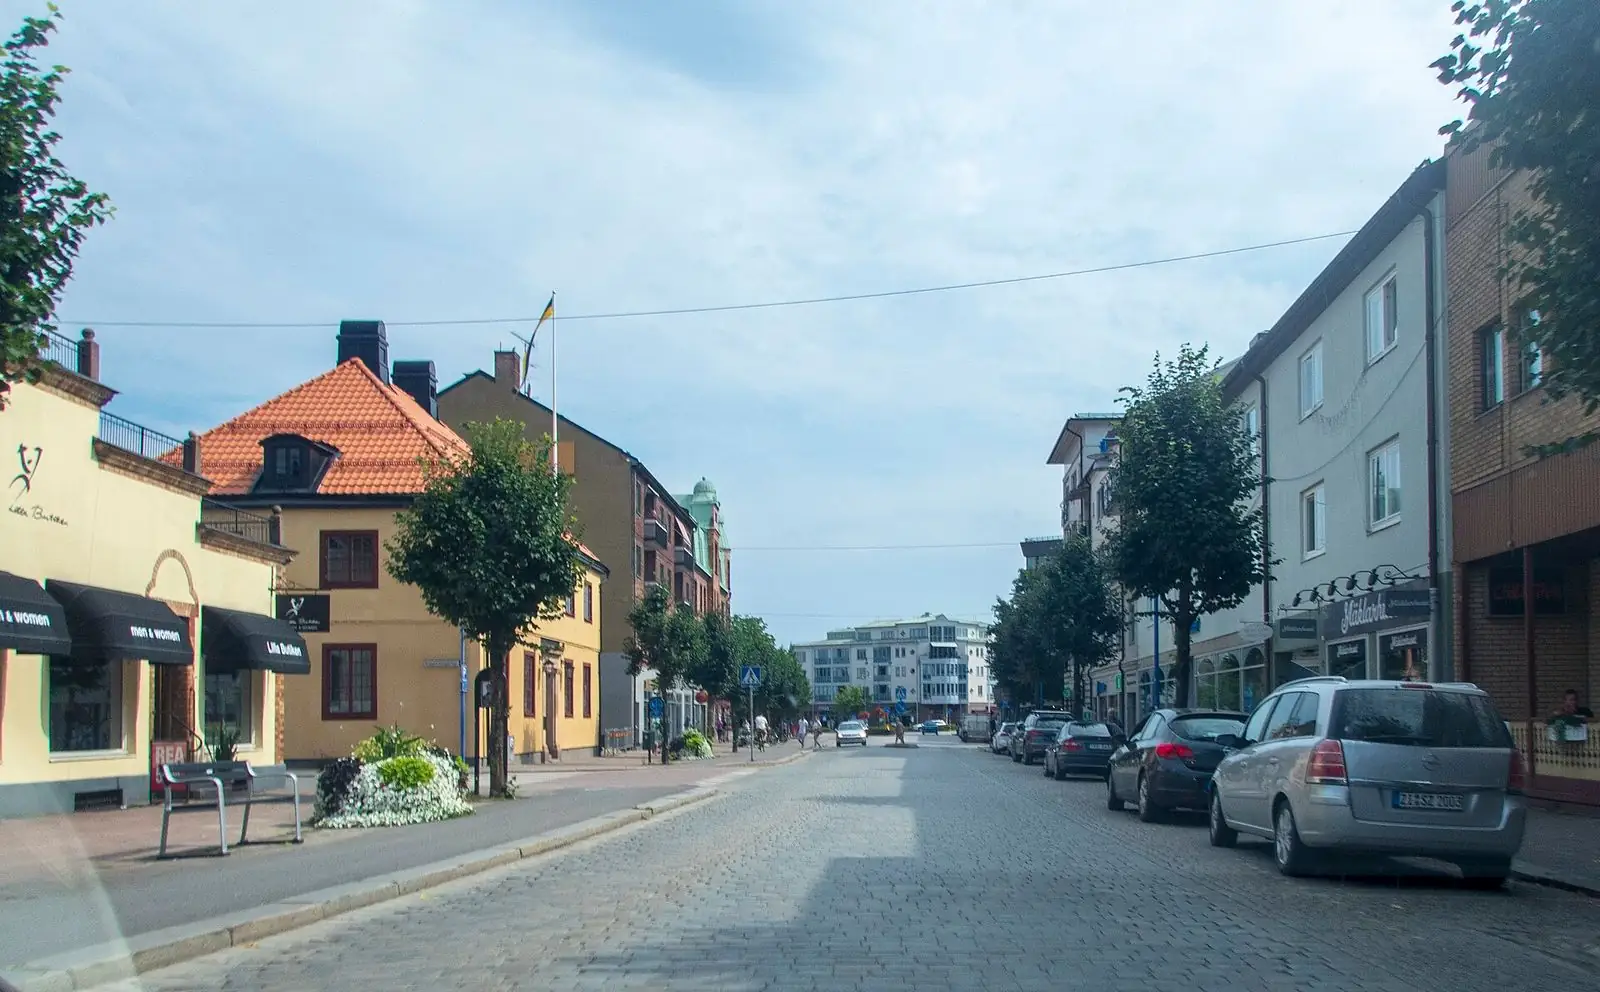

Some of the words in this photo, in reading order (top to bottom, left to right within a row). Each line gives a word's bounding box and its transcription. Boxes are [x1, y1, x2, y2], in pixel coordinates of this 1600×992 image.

[13, 611, 51, 627] women
[130, 625, 148, 638] men
[153, 628, 181, 642] women
[155, 745, 184, 764] REA
